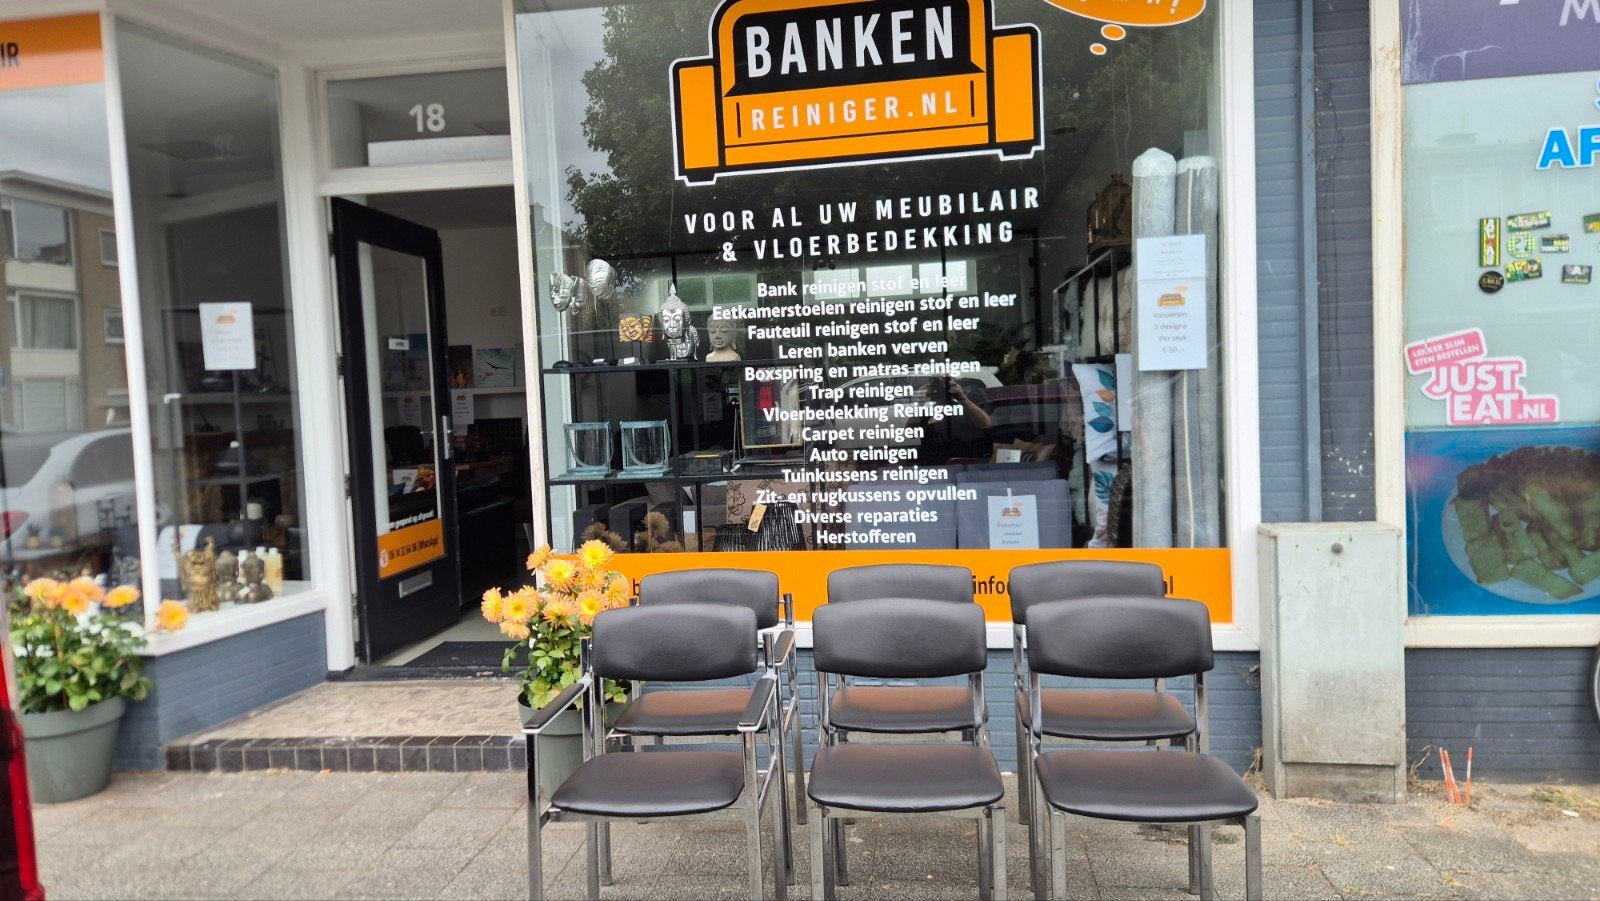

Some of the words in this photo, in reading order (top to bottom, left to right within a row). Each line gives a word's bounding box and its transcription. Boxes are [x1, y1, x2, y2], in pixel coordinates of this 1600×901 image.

[745, 6, 953, 78] BANKEN
[409, 103, 446, 132] 18
[751, 91, 957, 131] REINIGER.NL
[684, 210, 755, 234] VOOR
[772, 206, 802, 228] AL
[819, 202, 857, 225] UW
[876, 187, 1039, 220] MEUBILAIR
[722, 241, 737, 262] &
[754, 221, 1013, 260] VLOERBEDEKKING
[757, 281, 797, 297] Bank
[802, 279, 866, 297] reinigen
[872, 275, 903, 291] stof
[910, 275, 930, 289] en
[935, 273, 965, 288] leer
[712, 301, 845, 320] Eetkamerstoelen
[850, 298, 915, 316] reinigen
[920, 293, 953, 311] stof
[958, 295, 980, 309] en
[984, 291, 1017, 308] leer
[748, 322, 811, 340] Fauteuil
[815, 319, 879, 338] reinigen
[884, 316, 918, 334] stof
[922, 319, 943, 332] en
[948, 315, 980, 331] leer
[779, 344, 823, 359] Leren
[827, 341, 886, 358] banken
[891, 340, 948, 355] verven
[1412, 345, 1443, 358] LEKKER
[1444, 339, 1466, 350] SLIM
[1414, 356, 1435, 367] ETEN
[1436, 344, 1480, 361] BESTELLEN
[744, 365, 823, 384] Boxspring
[828, 366, 848, 379] en
[852, 363, 909, 378] matras
[913, 358, 981, 377] reinigen
[1431, 364, 1519, 393] JUST
[808, 385, 844, 402] Trap
[849, 382, 914, 401] reinigen
[763, 403, 888, 423] Vloerbedekking
[893, 401, 964, 420] Reinigen
[802, 426, 855, 444] Carpet
[859, 424, 924, 442] reinigen
[809, 448, 848, 462] Auto
[853, 446, 918, 464] reinigen
[781, 468, 878, 483] Tuinkussens
[882, 466, 948, 484] reinigen
[756, 489, 783, 504] Zit-
[787, 491, 807, 504] en
[811, 487, 901, 506] rugkussens
[906, 485, 977, 504] opvullen
[794, 509, 852, 524] Diverse
[857, 507, 938, 526] reparaties
[816, 529, 916, 545] Herstofferen
